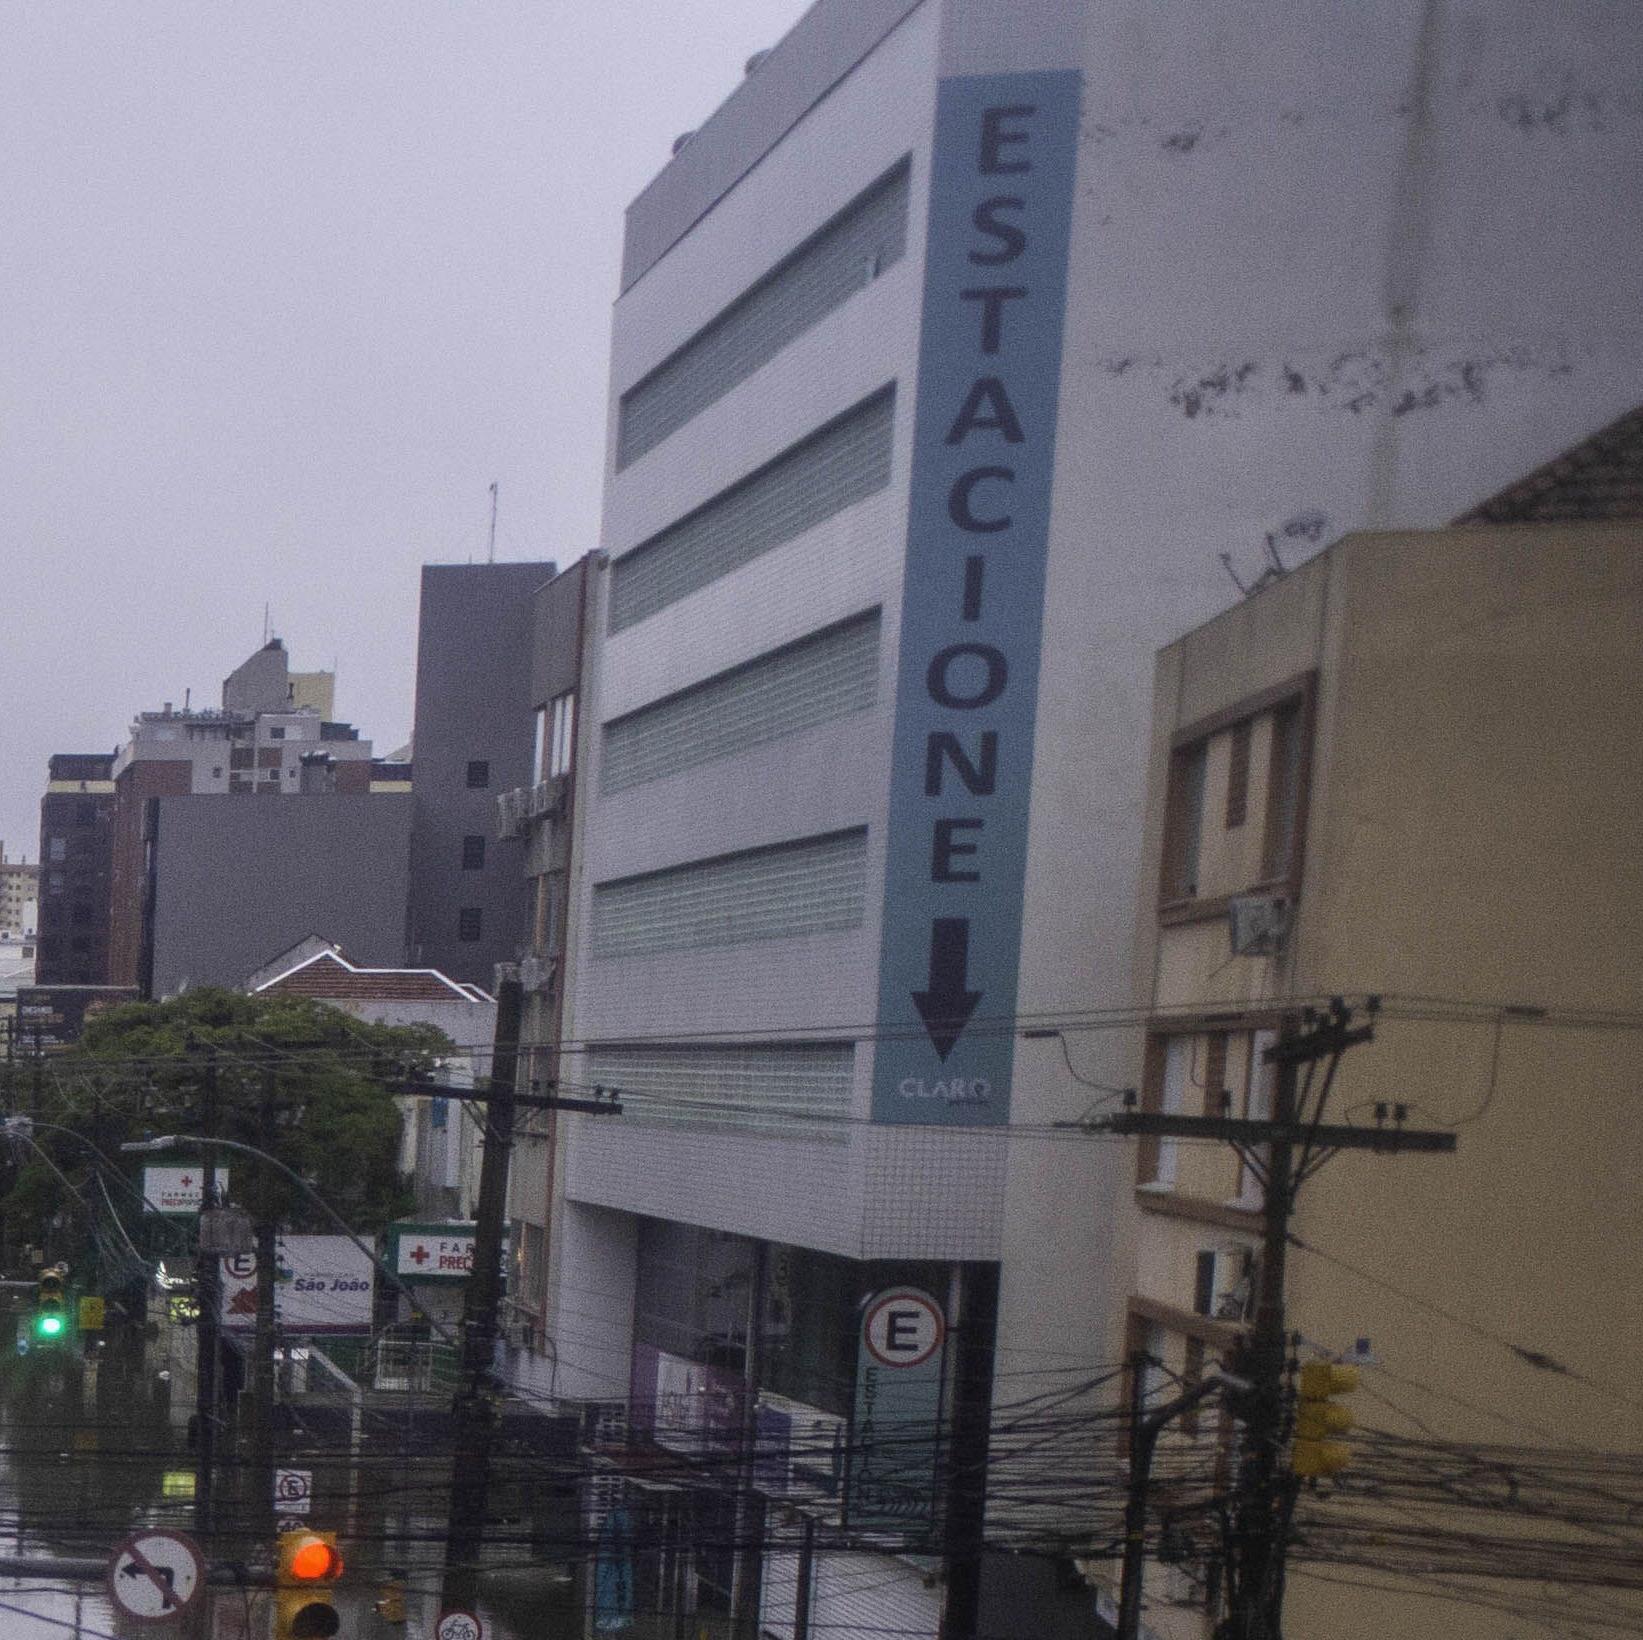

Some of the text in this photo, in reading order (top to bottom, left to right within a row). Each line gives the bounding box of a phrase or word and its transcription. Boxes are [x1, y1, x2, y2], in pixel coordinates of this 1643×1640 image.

[923, 103, 1037, 884] ESTACIONE
[896, 1077, 992, 1100] CLARO
[294, 1278, 370, 1292] São João
[885, 1310, 921, 1352] E
